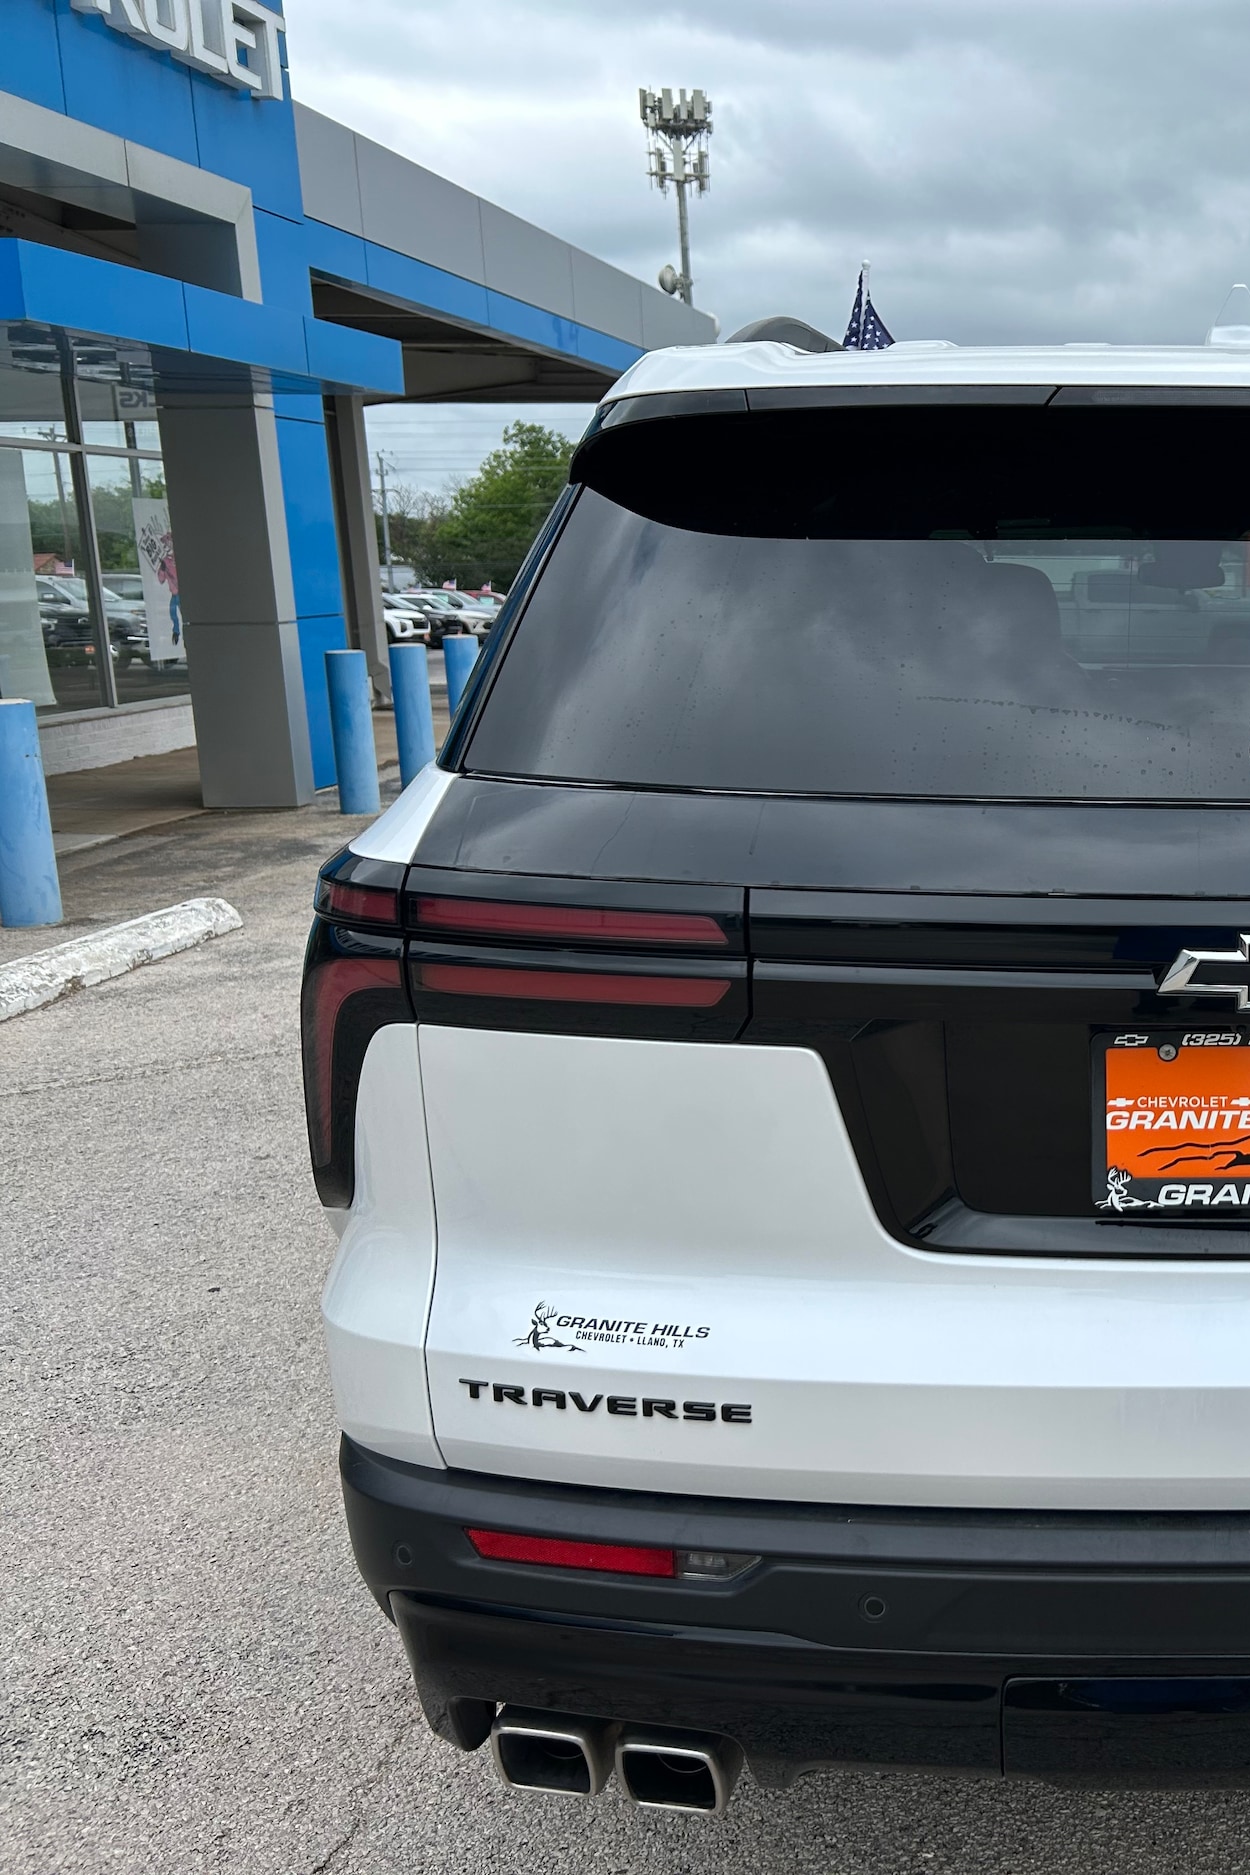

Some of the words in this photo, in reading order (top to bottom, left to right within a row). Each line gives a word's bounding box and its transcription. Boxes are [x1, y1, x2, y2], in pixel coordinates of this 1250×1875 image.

[1181, 1033, 1241, 1046] (325)
[1137, 1096, 1228, 1108] CHEVROLET
[556, 1315, 648, 1334] GRANITE
[651, 1323, 711, 1339] HILLS
[575, 1330, 627, 1344] CHEVROLET
[636, 1336, 669, 1349] LLANO,
[673, 1339, 685, 1348] TX
[458, 1378, 752, 1424] TRAVERSE
